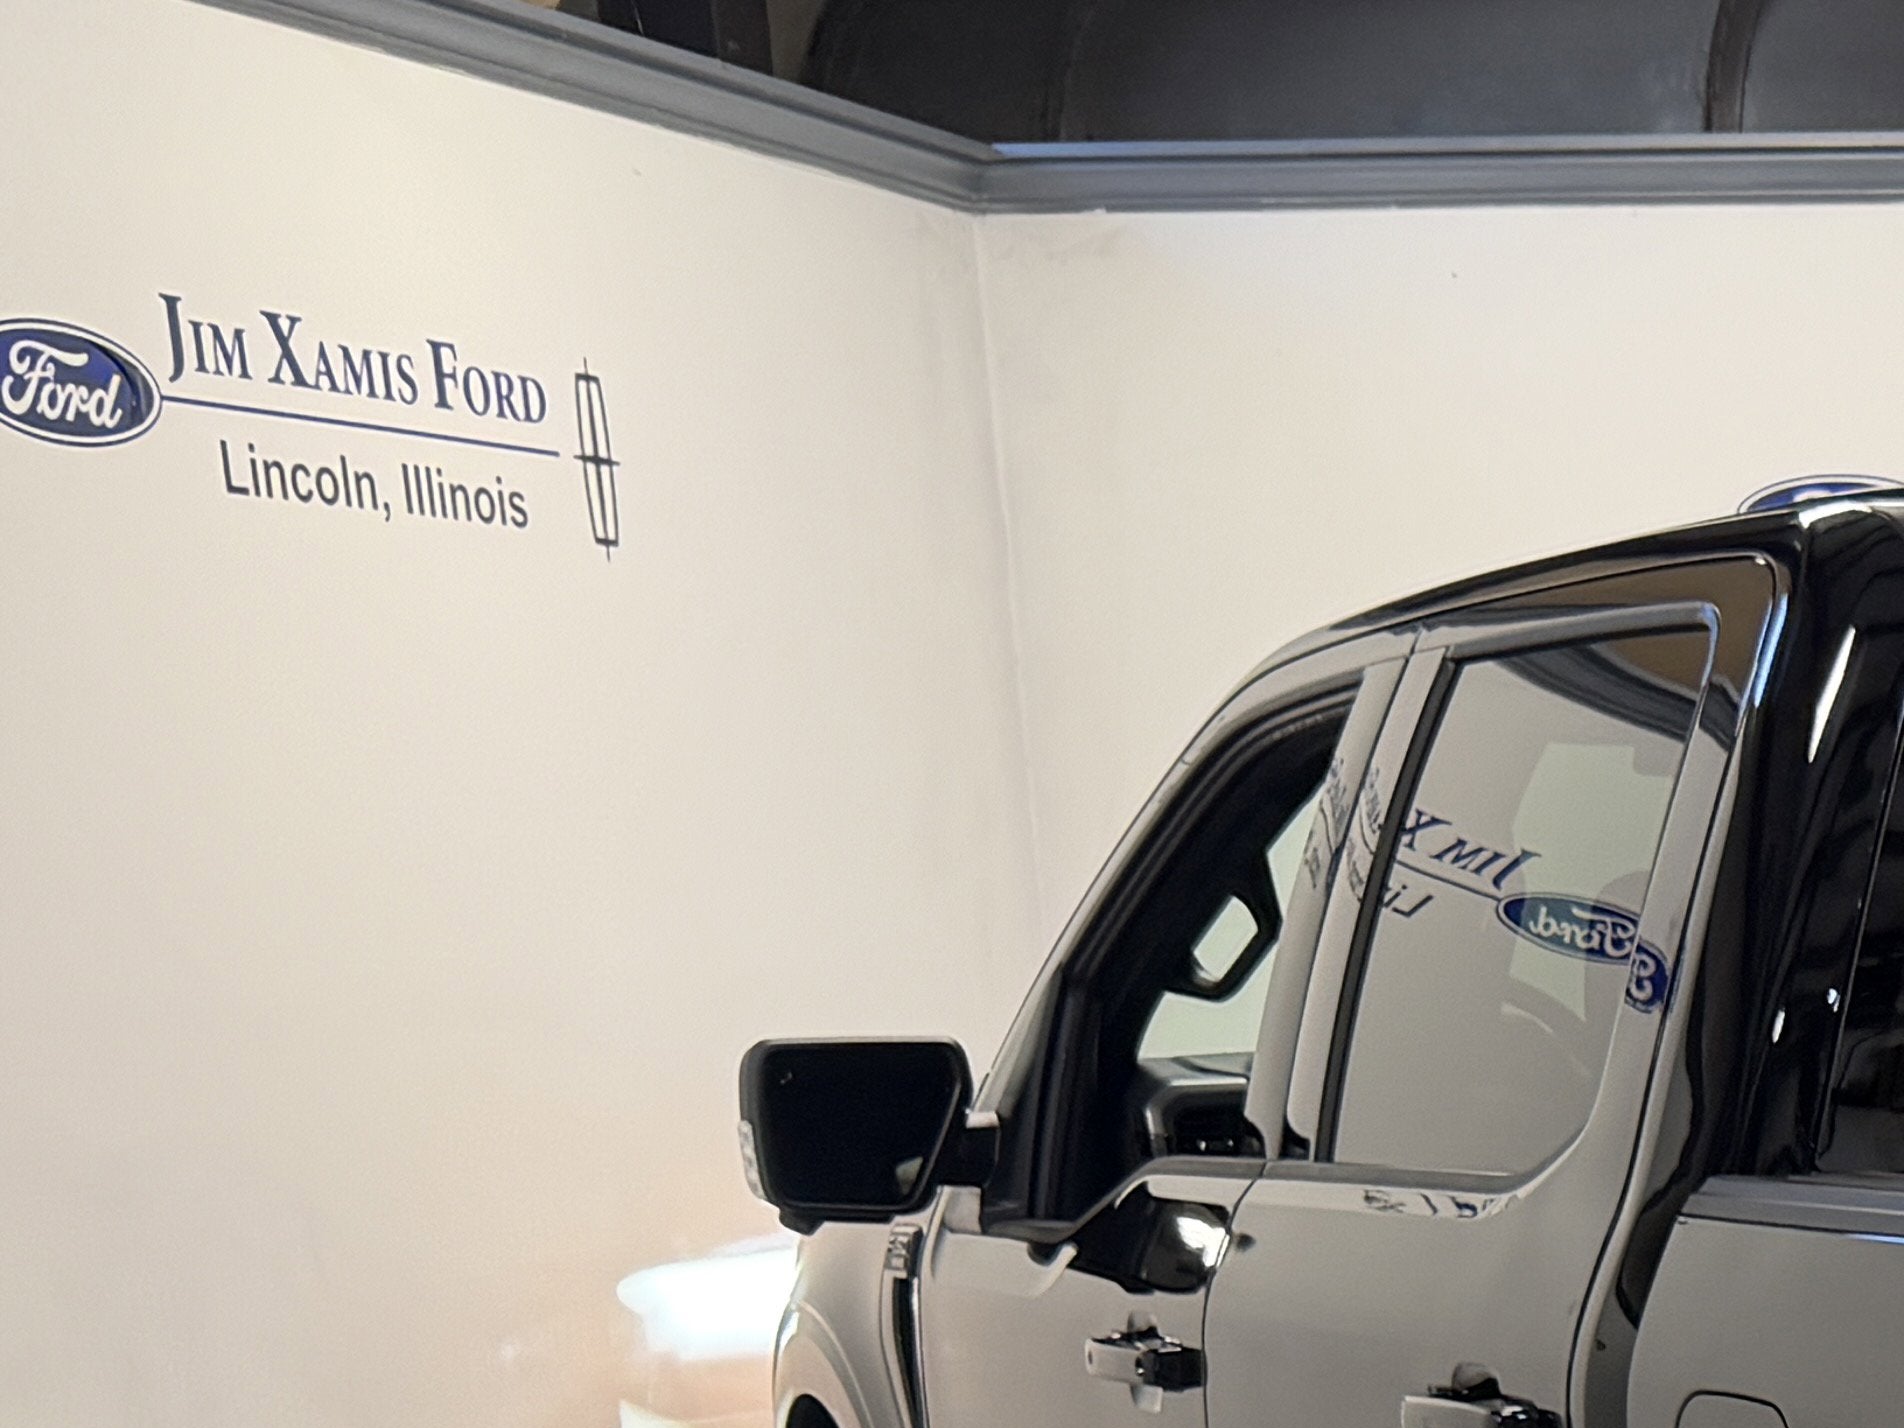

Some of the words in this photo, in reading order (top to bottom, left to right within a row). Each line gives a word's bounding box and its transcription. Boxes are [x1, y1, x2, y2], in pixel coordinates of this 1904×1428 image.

[2, 340, 122, 428] Ford
[158, 292, 252, 384] JIM
[260, 309, 418, 405] XAMIS
[426, 338, 547, 424] FORD
[220, 439, 393, 522] Lincoln,
[402, 462, 530, 529] Illinois
